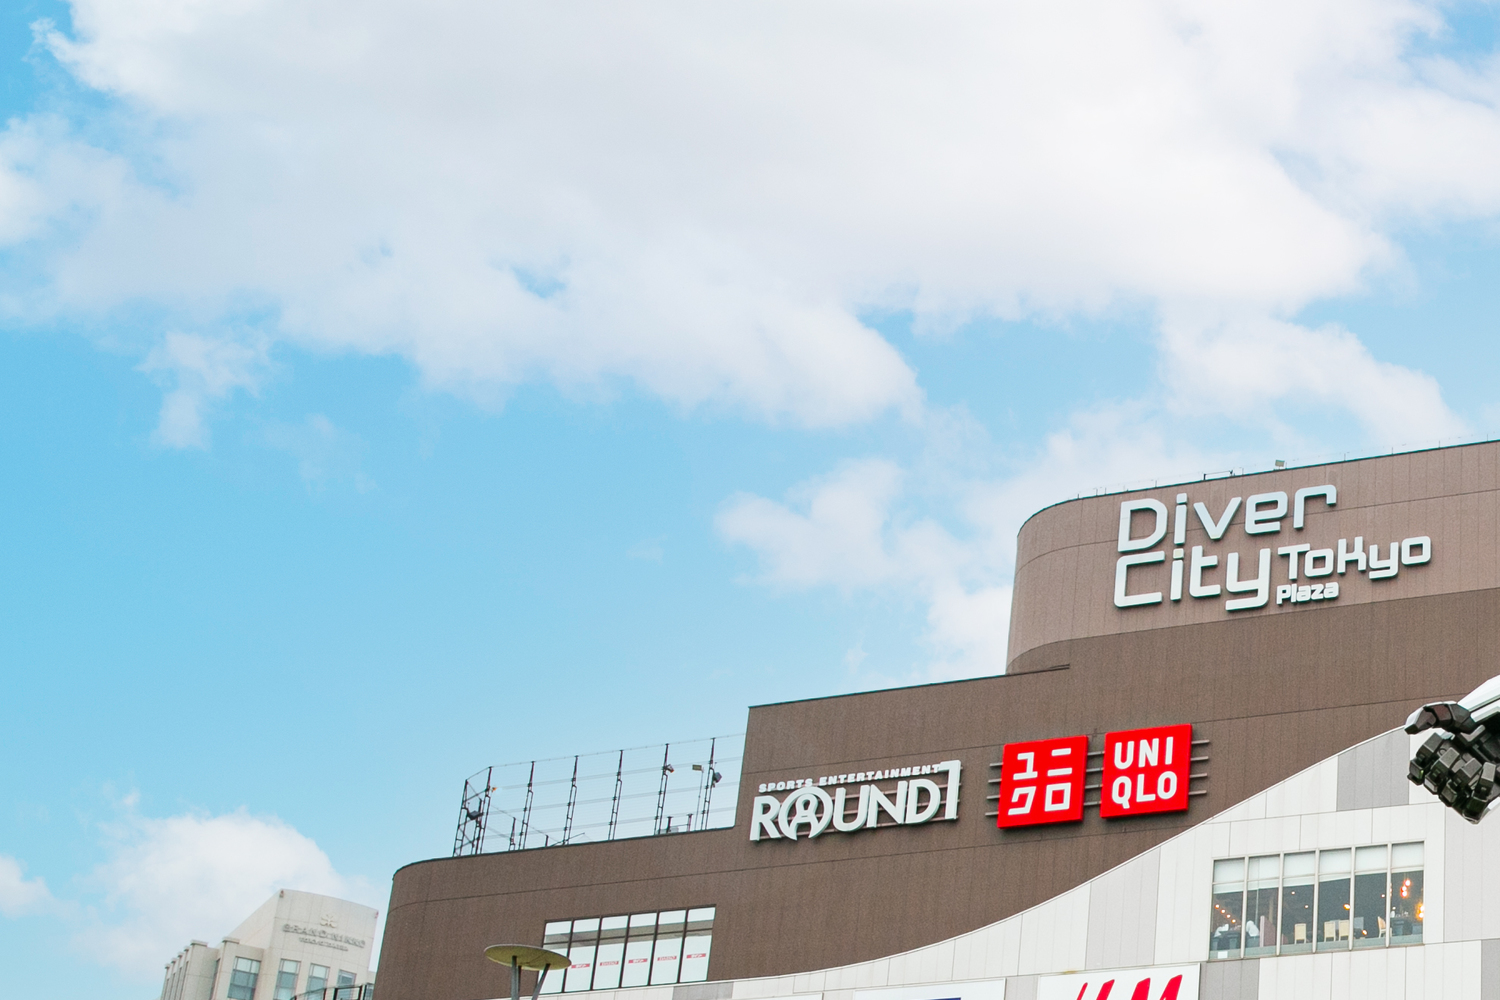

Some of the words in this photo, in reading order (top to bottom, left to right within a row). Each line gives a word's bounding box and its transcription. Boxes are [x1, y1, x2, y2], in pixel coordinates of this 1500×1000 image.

[1117, 483, 1338, 553] Diver
[1113, 544, 1272, 611] City
[1276, 581, 1339, 605] Plaza
[1113, 736, 1174, 770] UNI
[758, 778, 813, 793] SPORTS
[819, 763, 940, 787] ENTERTAINMENT
[1111, 770, 1178, 809] QLO
